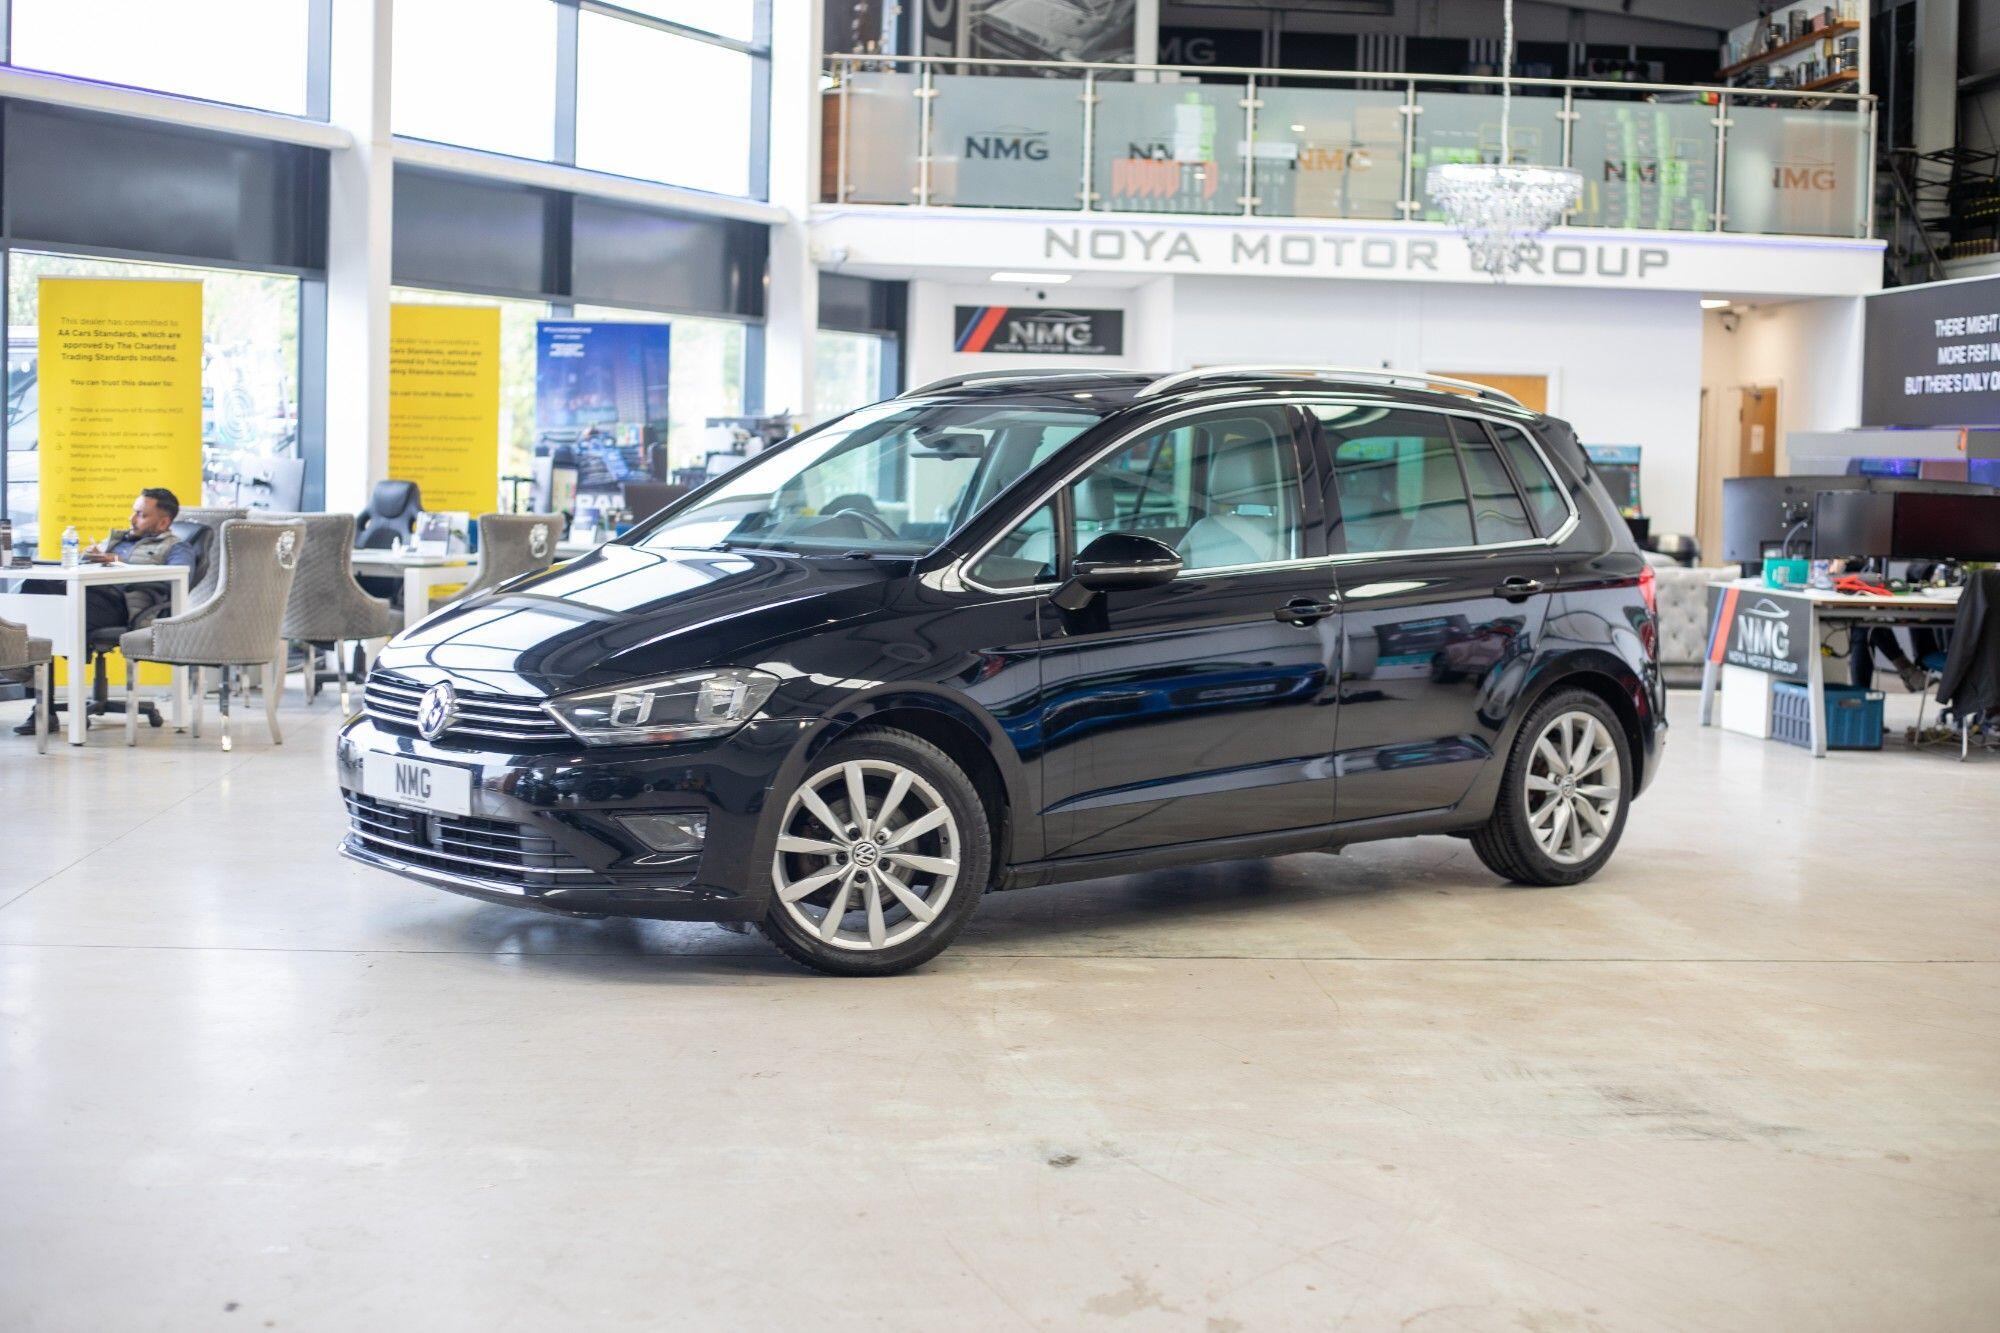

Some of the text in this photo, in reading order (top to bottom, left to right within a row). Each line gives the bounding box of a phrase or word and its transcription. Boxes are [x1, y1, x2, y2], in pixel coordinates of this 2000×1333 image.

[1159, 37, 1216, 64] MG
[965, 136, 1048, 160] NMG
[1045, 228, 1200, 262] NOYA
[1232, 233, 1438, 270] MOTOR
[72, 329, 91, 337] Cars
[1008, 321, 1092, 345] NMG
[1935, 314, 1998, 338] THERE MIGHT
[1937, 345, 1967, 365] MORE
[1967, 344, 1990, 363] FISH
[1905, 376, 1924, 395] BUT
[1963, 372, 1990, 392] ONLY
[1737, 614, 1789, 660] NMG
[396, 763, 430, 799] NMG
